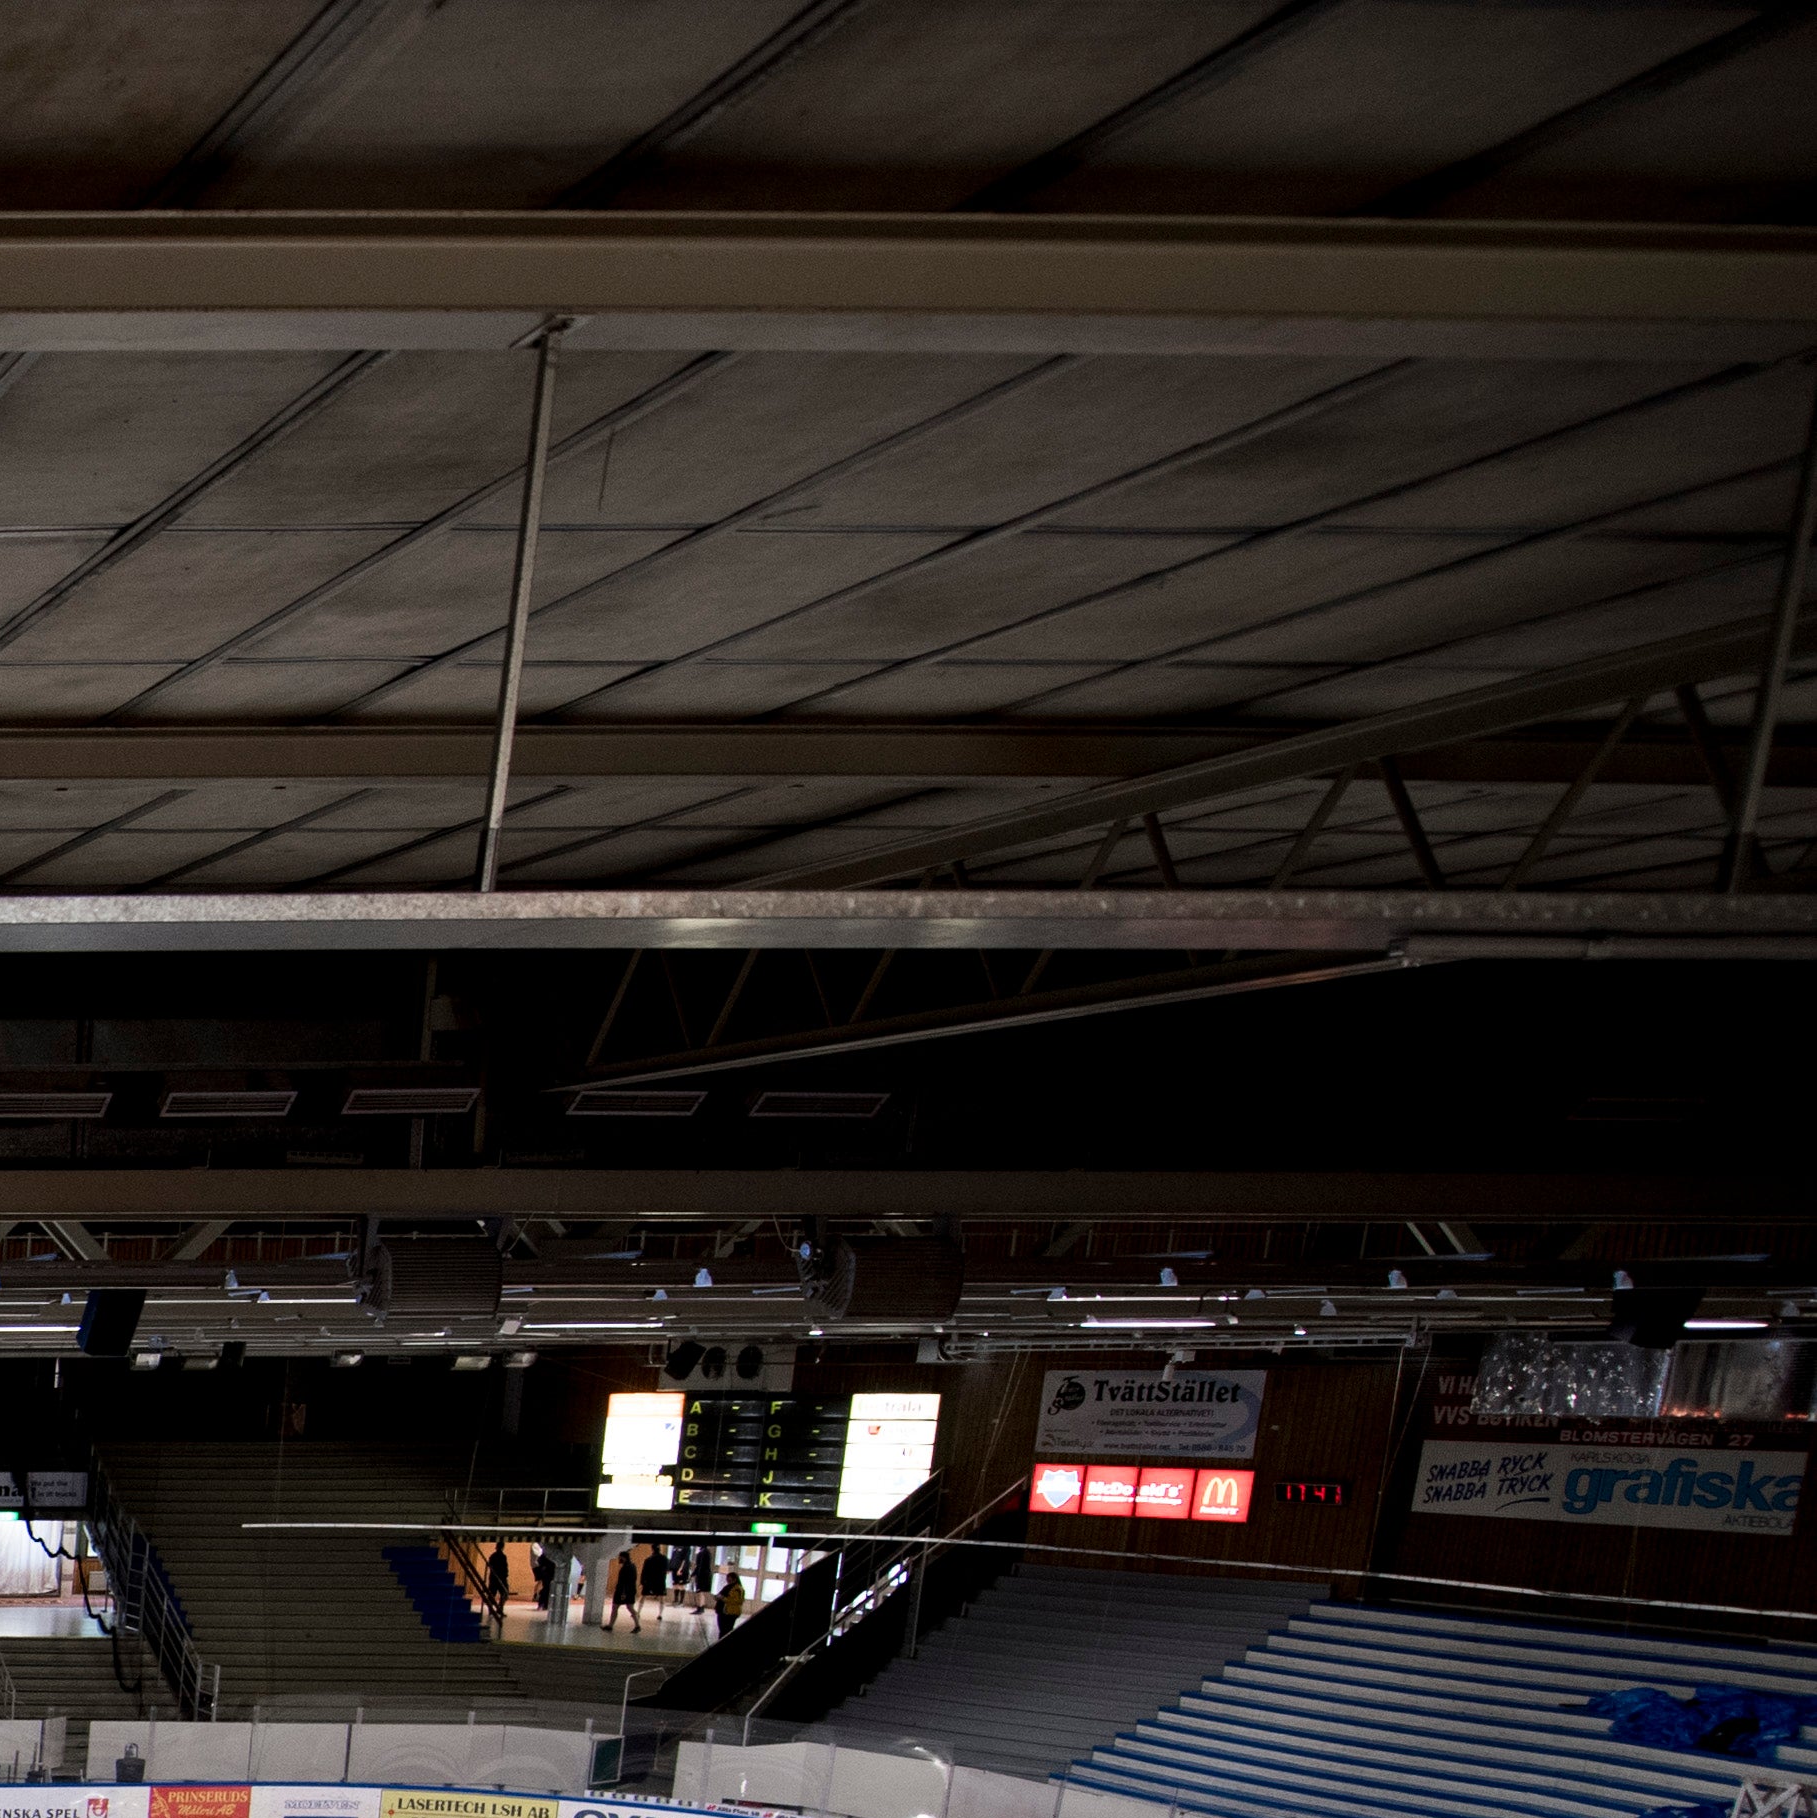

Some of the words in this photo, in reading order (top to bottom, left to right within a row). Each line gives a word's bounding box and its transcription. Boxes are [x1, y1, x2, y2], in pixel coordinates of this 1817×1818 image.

[1094, 1379, 1241, 1403] TvättStället
[690, 1402, 702, 1414] A
[770, 1402, 783, 1415] F
[1433, 1406, 1470, 1427] VVS
[686, 1424, 699, 1436] B
[767, 1425, 782, 1438] G
[1559, 1429, 1716, 1447] BLOMSTERVÄGEN
[1728, 1434, 1755, 1448] 27
[684, 1446, 697, 1459] C
[764, 1448, 778, 1461] H
[1571, 1450, 1652, 1464] KARLSKOGA
[1429, 1459, 1491, 1483] SNABBA
[1498, 1451, 1547, 1476] RYCK
[681, 1468, 694, 1481] D
[762, 1472, 774, 1484] J
[1423, 1482, 1487, 1504] SNABBA
[1497, 1474, 1553, 1497] TRYCK
[1562, 1457, 1804, 1515] grafiska
[678, 1491, 691, 1504] E
[759, 1493, 772, 1507] K
[168, 1790, 249, 1804] PRINSERUDS
[215, 1803, 237, 1816] AB
[284, 1799, 360, 1811] MOELVEN
[397, 1797, 486, 1815] LASERTECH
[491, 1801, 522, 1817] LSH
